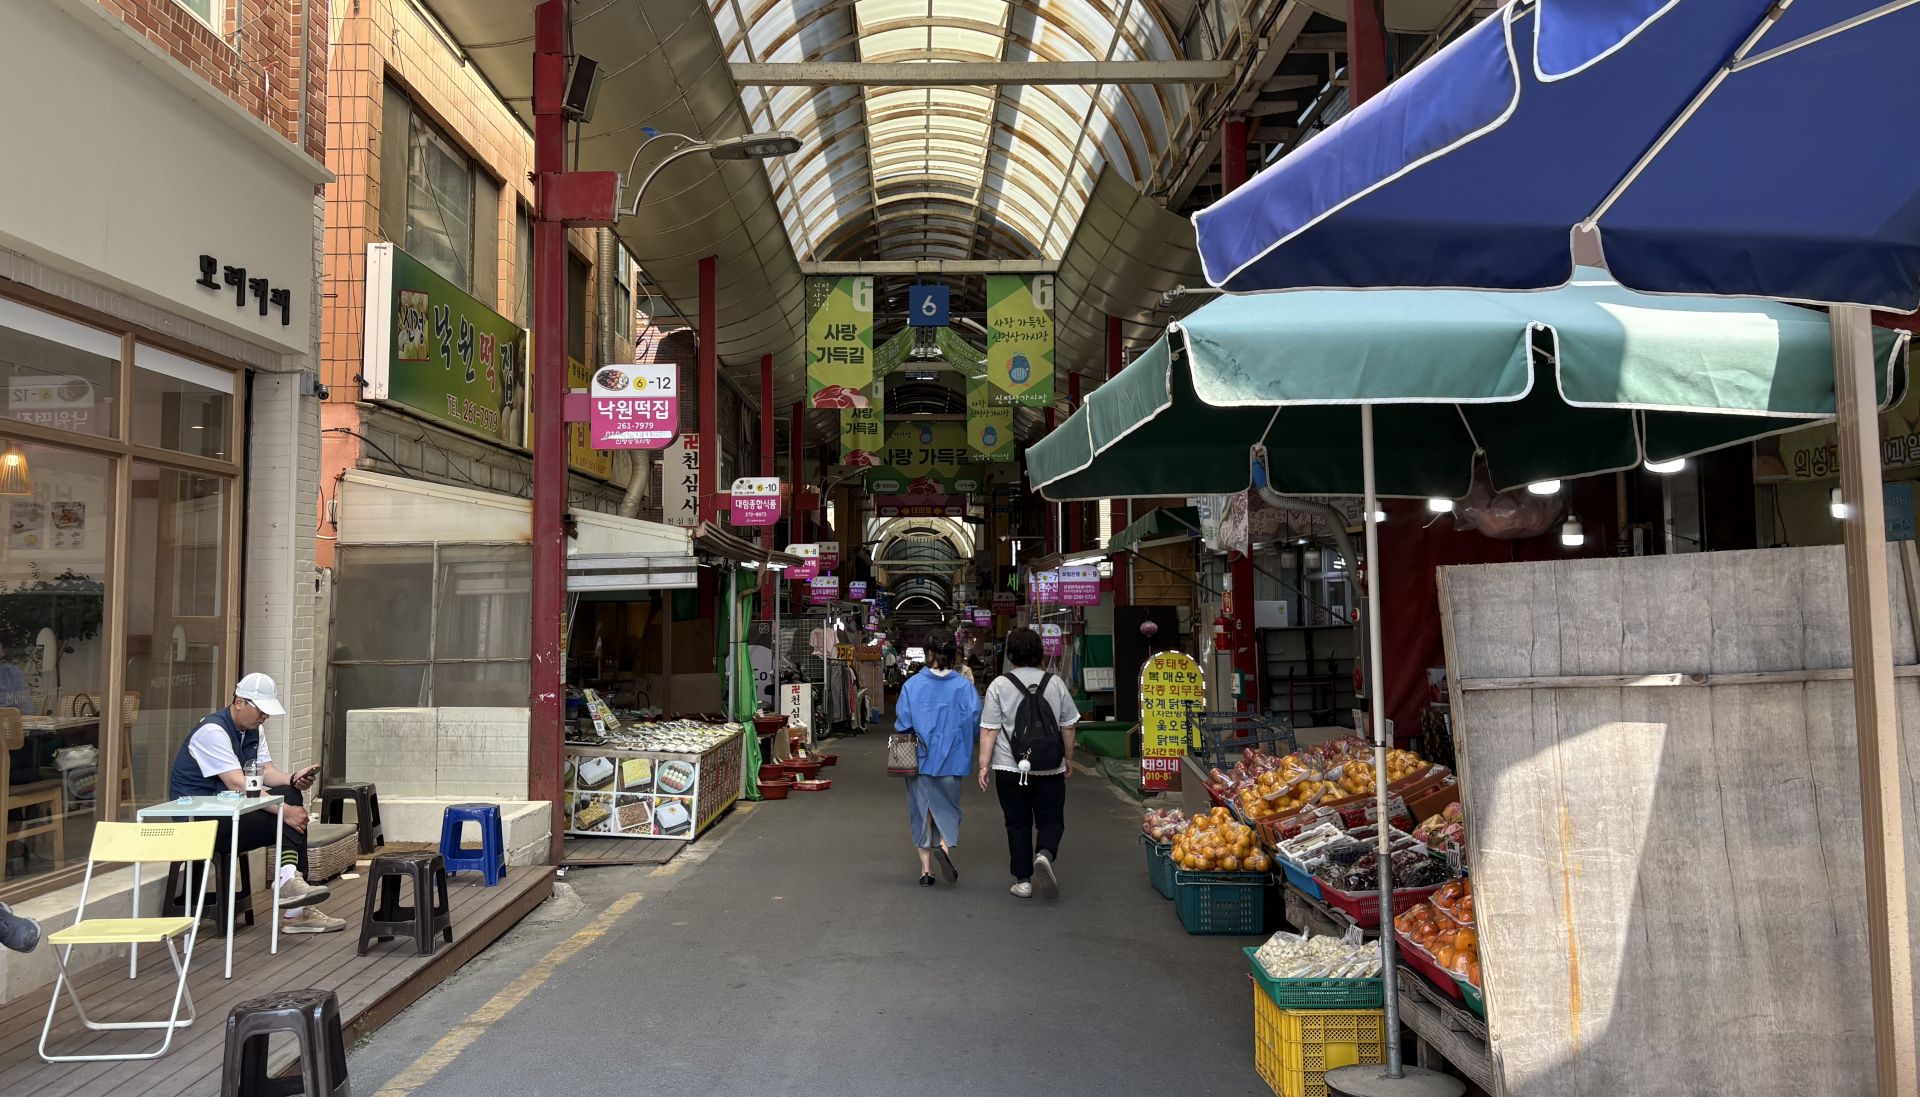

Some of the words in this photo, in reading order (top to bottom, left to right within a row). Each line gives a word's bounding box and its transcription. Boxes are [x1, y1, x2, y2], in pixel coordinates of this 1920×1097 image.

[921, 295, 937, 316] 6
[824, 323, 857, 341] 사랑
[434, 303, 514, 404] 낙원떡집
[816, 346, 864, 364] 가득길
[464, 399, 498, 432] 261-7979
[597, 400, 669, 420] 낙원떡집
[845, 422, 878, 435] 가득길
[681, 451, 699, 515] 천심사
[1155, 658, 1189, 670] 동태탕
[1163, 671, 1197, 683] 매운탕
[1144, 685, 1166, 696] 각종
[1169, 685, 1203, 697] 회무침
[1145, 748, 1166, 756] 2시간
[1144, 759, 1179, 772] 태희네
